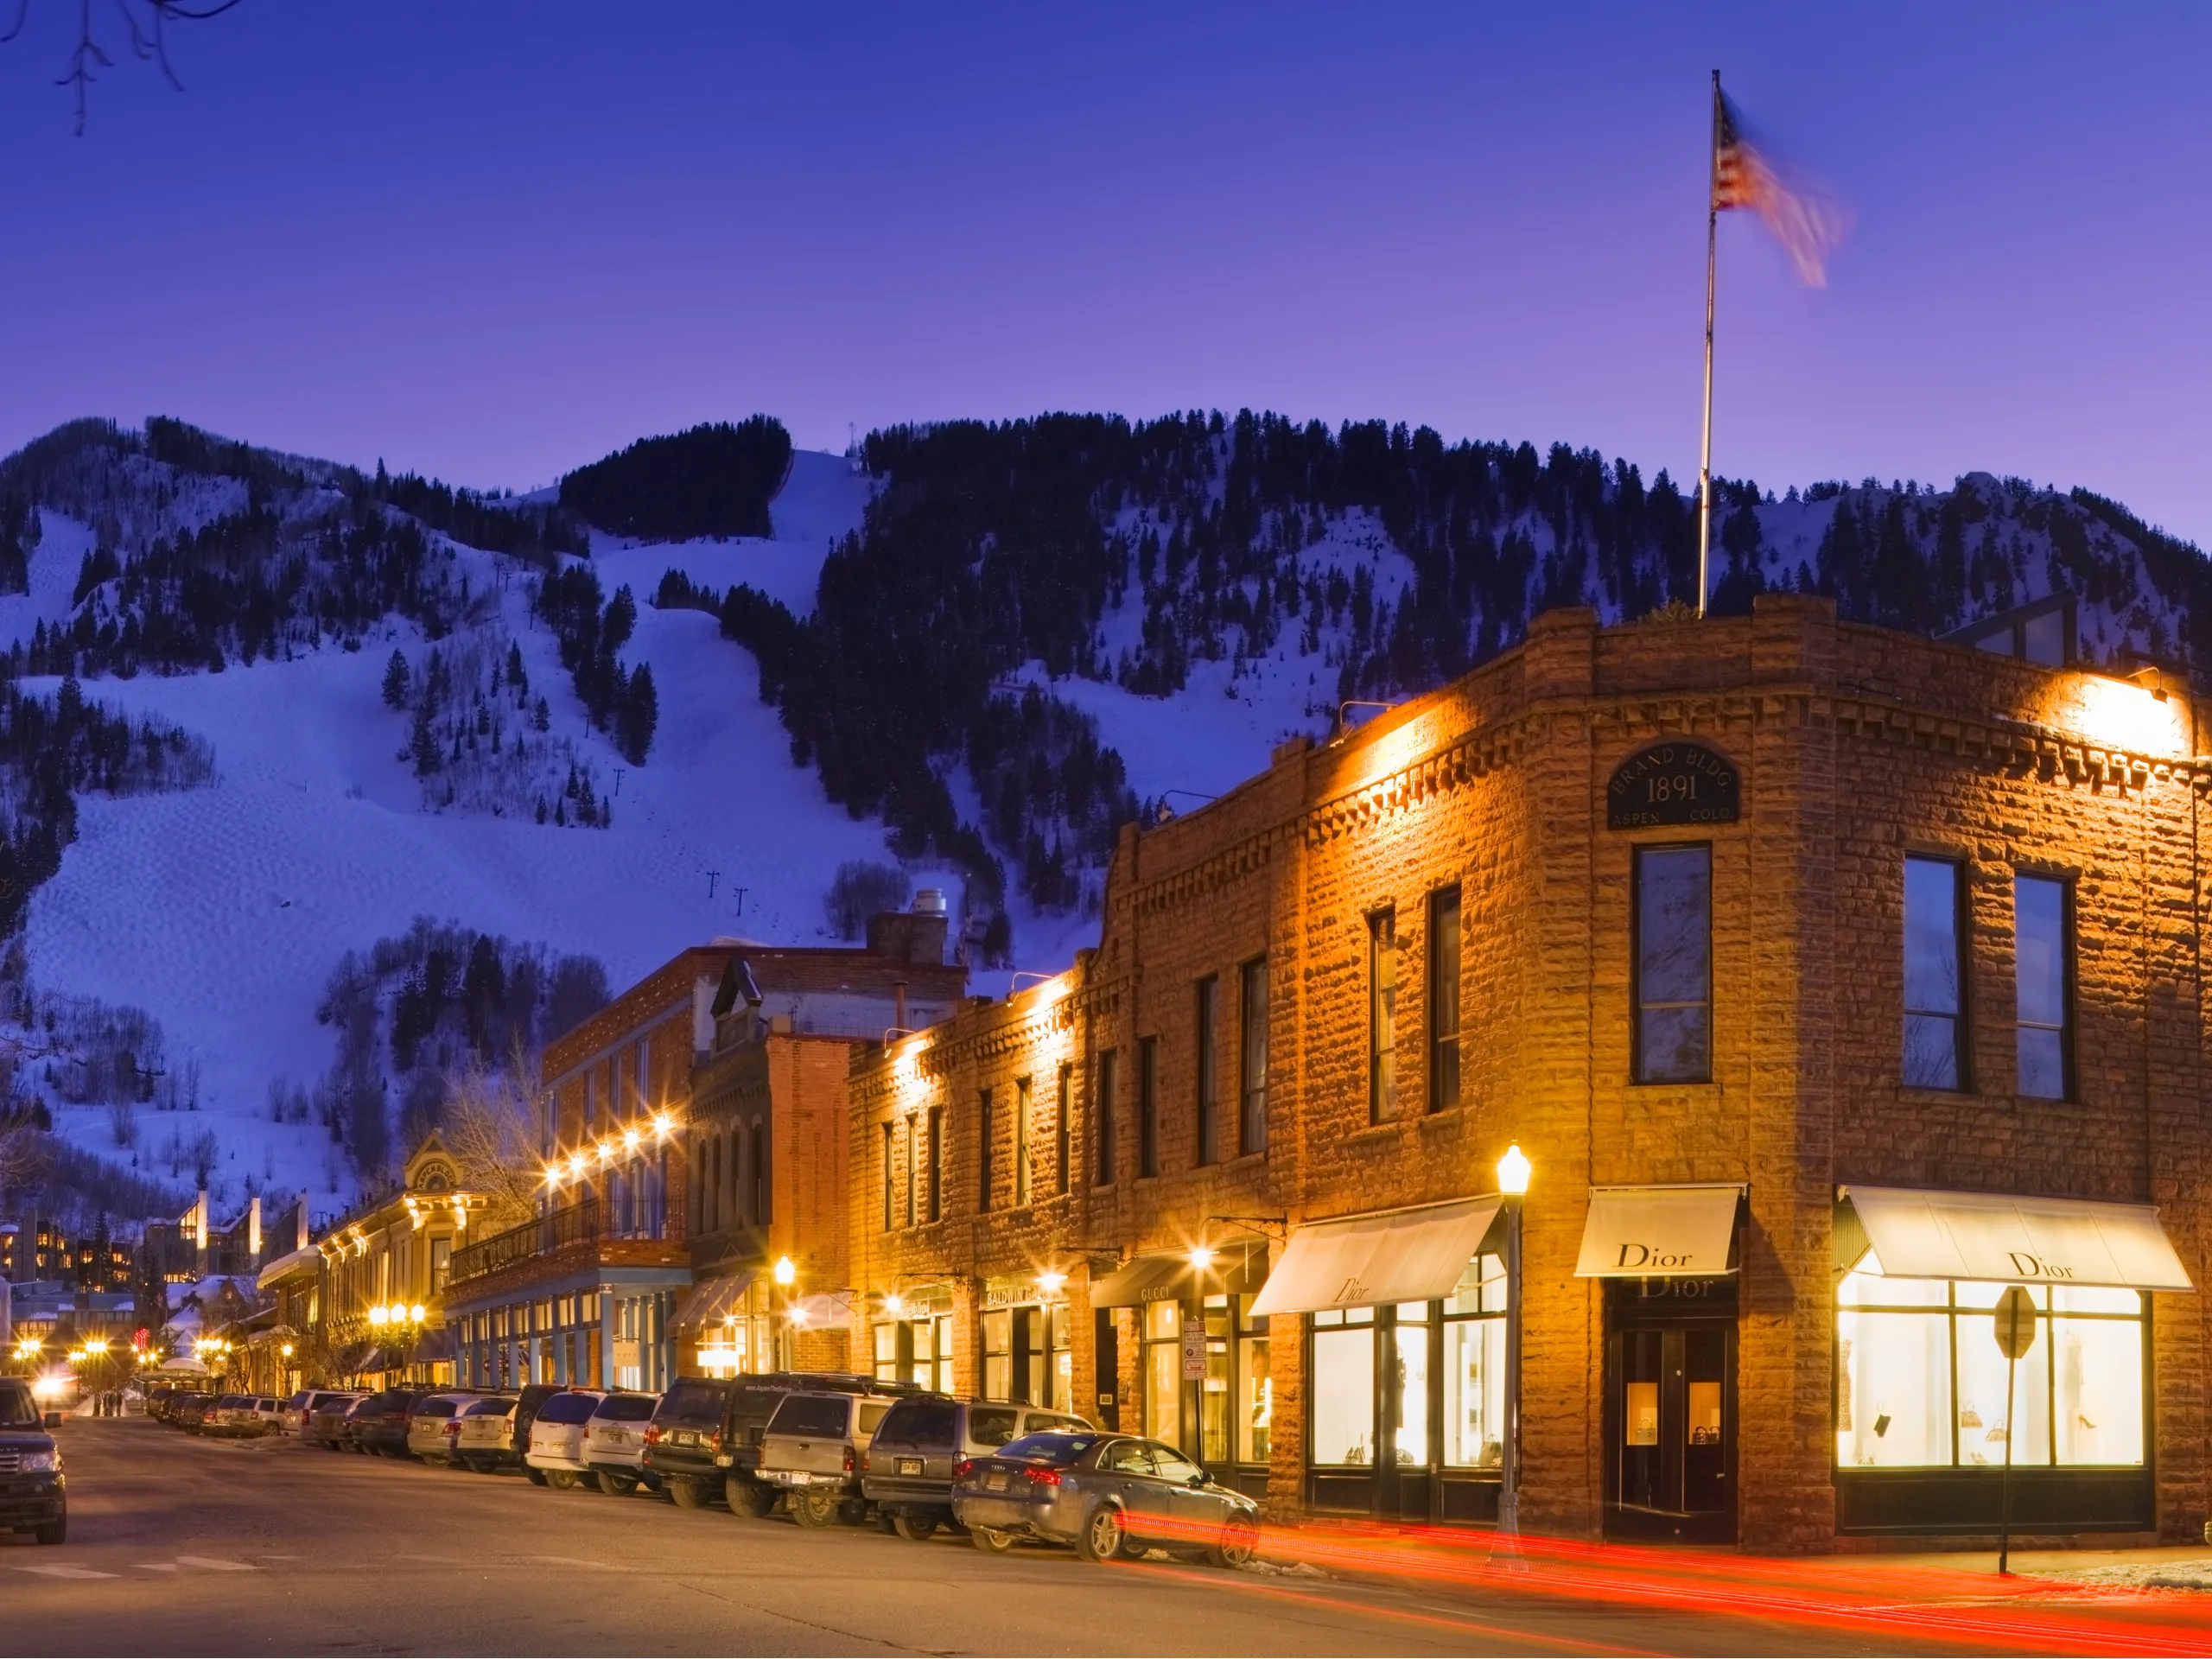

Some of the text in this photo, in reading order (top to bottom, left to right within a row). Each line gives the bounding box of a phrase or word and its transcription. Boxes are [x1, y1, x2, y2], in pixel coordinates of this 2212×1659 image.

[1611, 747, 1732, 795] BRAND BLDG.
[1647, 774, 1697, 803] 1891
[1612, 807, 1733, 825] ASPEN COLO.
[418, 1165, 455, 1189] ASPEN BLOCK
[1612, 1243, 1692, 1268] Dior
[2005, 1252, 2073, 1278] Dior
[988, 1285, 1024, 1306] BALDWIN
[1141, 1286, 1169, 1300] GUCCI
[1332, 1277, 1370, 1302] Dior
[1636, 1276, 1714, 1298] Dior
